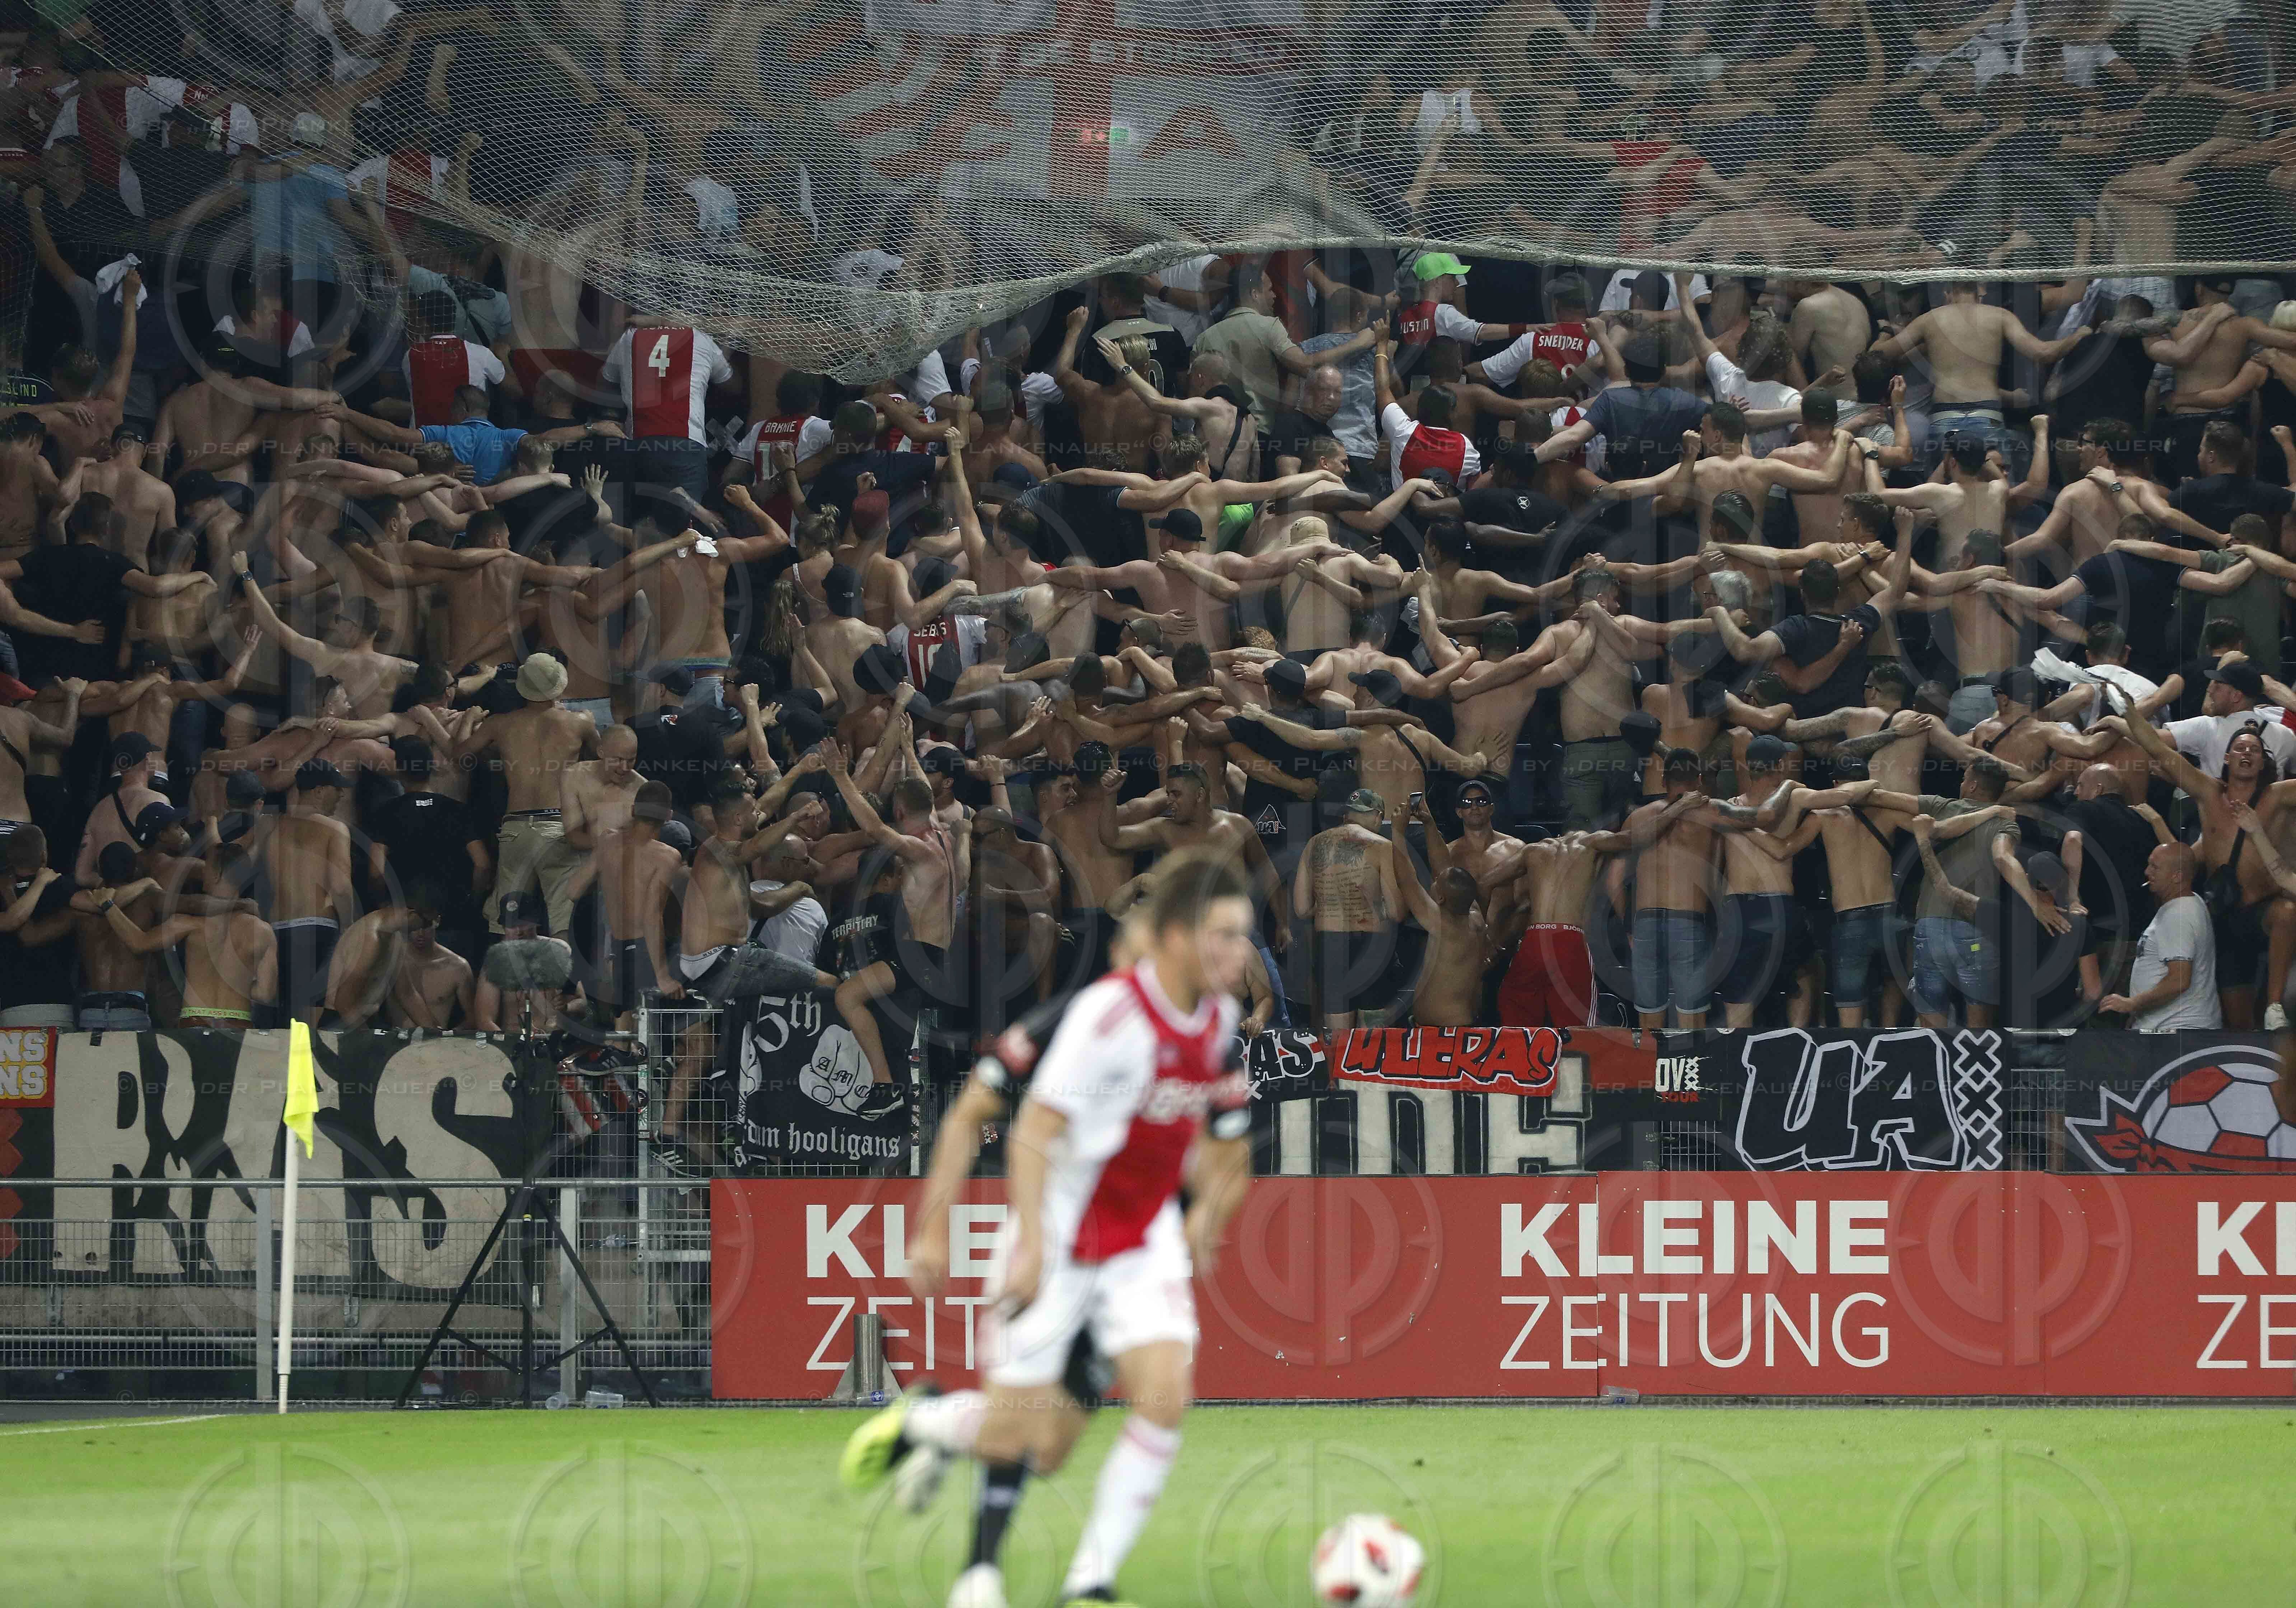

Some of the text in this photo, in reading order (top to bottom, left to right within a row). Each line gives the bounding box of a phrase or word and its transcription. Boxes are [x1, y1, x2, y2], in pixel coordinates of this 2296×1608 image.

[648, 335, 670, 377] 4
[1538, 335, 1584, 351] SNEIJDER
[754, 991, 821, 1053] 5th
[788, 1122, 900, 1160] hooligans
[1501, 1200, 1890, 1277] KLEINE
[1500, 1292, 1889, 1370] ZEITUNG
